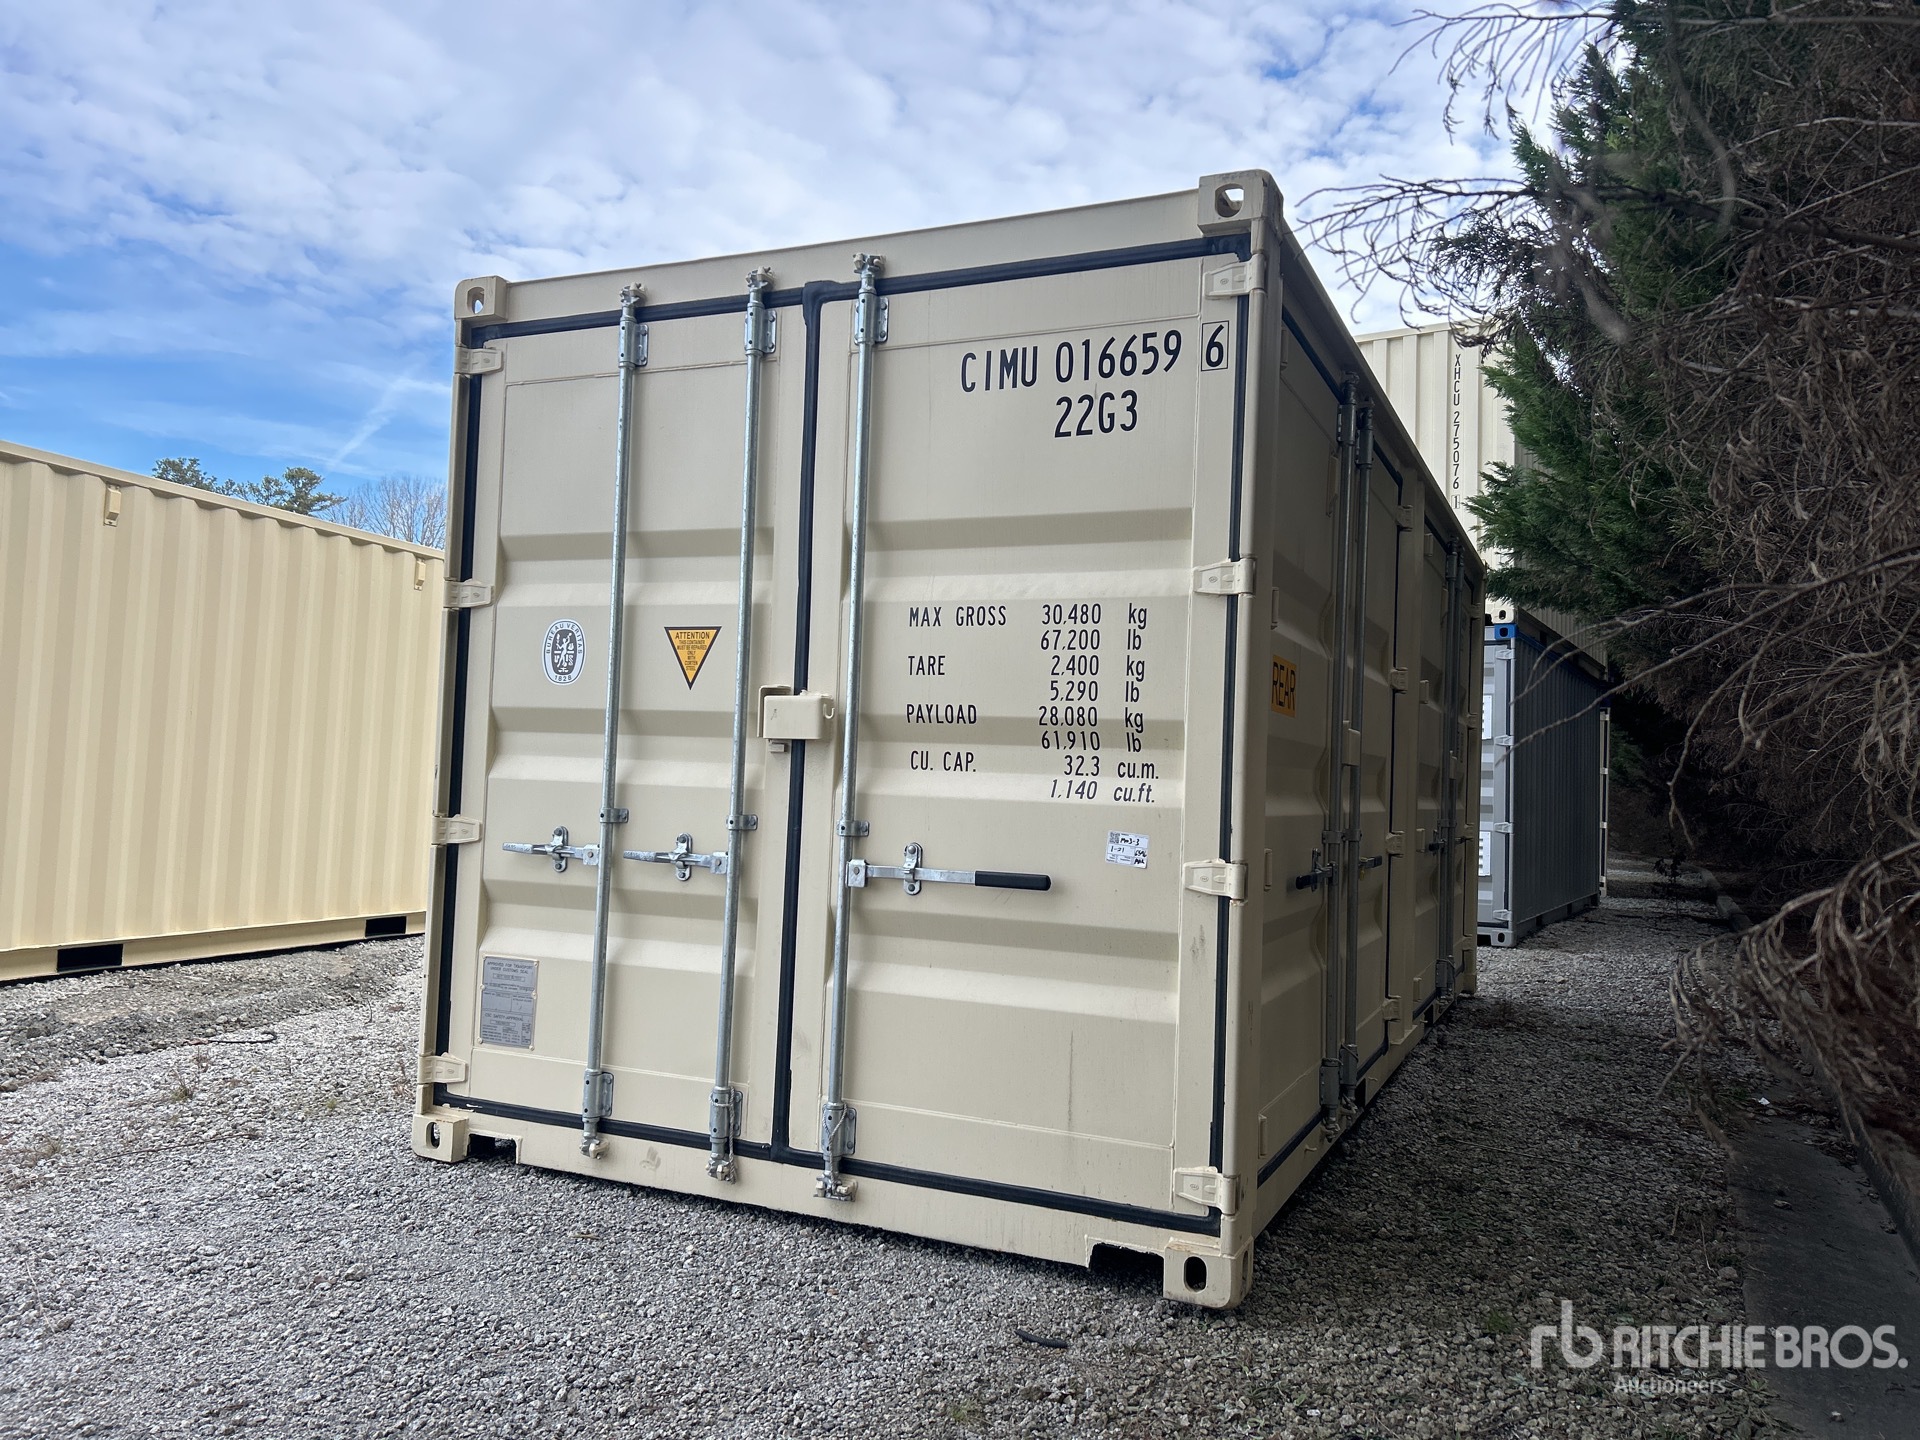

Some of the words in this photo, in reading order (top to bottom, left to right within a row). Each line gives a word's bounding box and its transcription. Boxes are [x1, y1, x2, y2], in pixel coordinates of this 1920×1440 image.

[961, 346, 1038, 392] CIMU
[1055, 329, 1182, 383] 016659
[1205, 324, 1225, 367] 6
[1453, 354, 1461, 406] XHCU
[1054, 389, 1138, 438] 22G3
[1452, 411, 1460, 490] 275076
[909, 607, 942, 627] MAX
[955, 606, 1007, 626] GROSS
[1128, 603, 1148, 629] kg
[546, 623, 564, 654] BUREAU
[566, 623, 582, 654] VERITAS
[675, 631, 710, 640] ATTENTION
[1127, 629, 1142, 650] lb
[908, 655, 946, 676] TARE
[1126, 655, 1145, 682] kg
[1125, 681, 1140, 702] lb
[1272, 661, 1296, 711] REAR
[906, 703, 977, 724] PAYLOAD
[1124, 707, 1144, 733] kg
[1127, 732, 1142, 752] lb
[910, 750, 934, 771] CU.
[943, 751, 977, 772] CAP.
[1063, 755, 1100, 777] 32.3
[1117, 761, 1159, 780] cu.m.
[1113, 782, 1155, 803] cu.ft.
